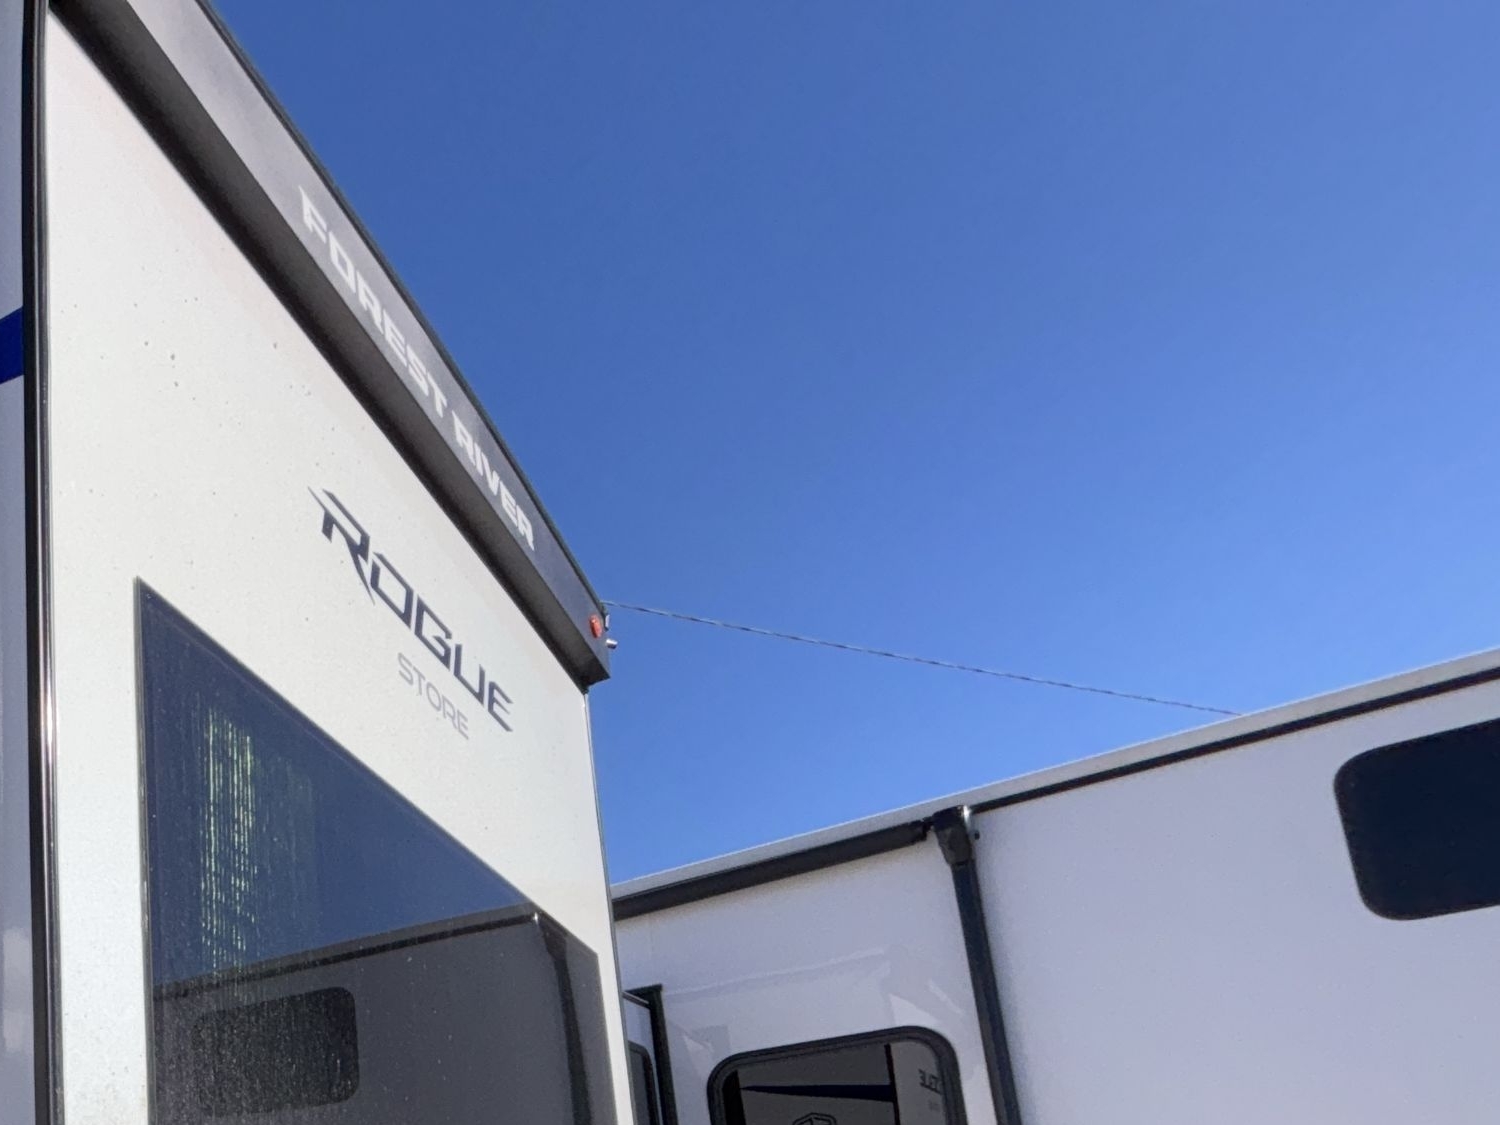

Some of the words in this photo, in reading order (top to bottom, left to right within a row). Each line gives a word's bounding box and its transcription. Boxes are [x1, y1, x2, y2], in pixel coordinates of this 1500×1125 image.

[299, 186, 447, 418] FOREST
[452, 411, 535, 552] RIVER
[307, 486, 513, 732] ROGUE
[397, 651, 470, 741] STORE
